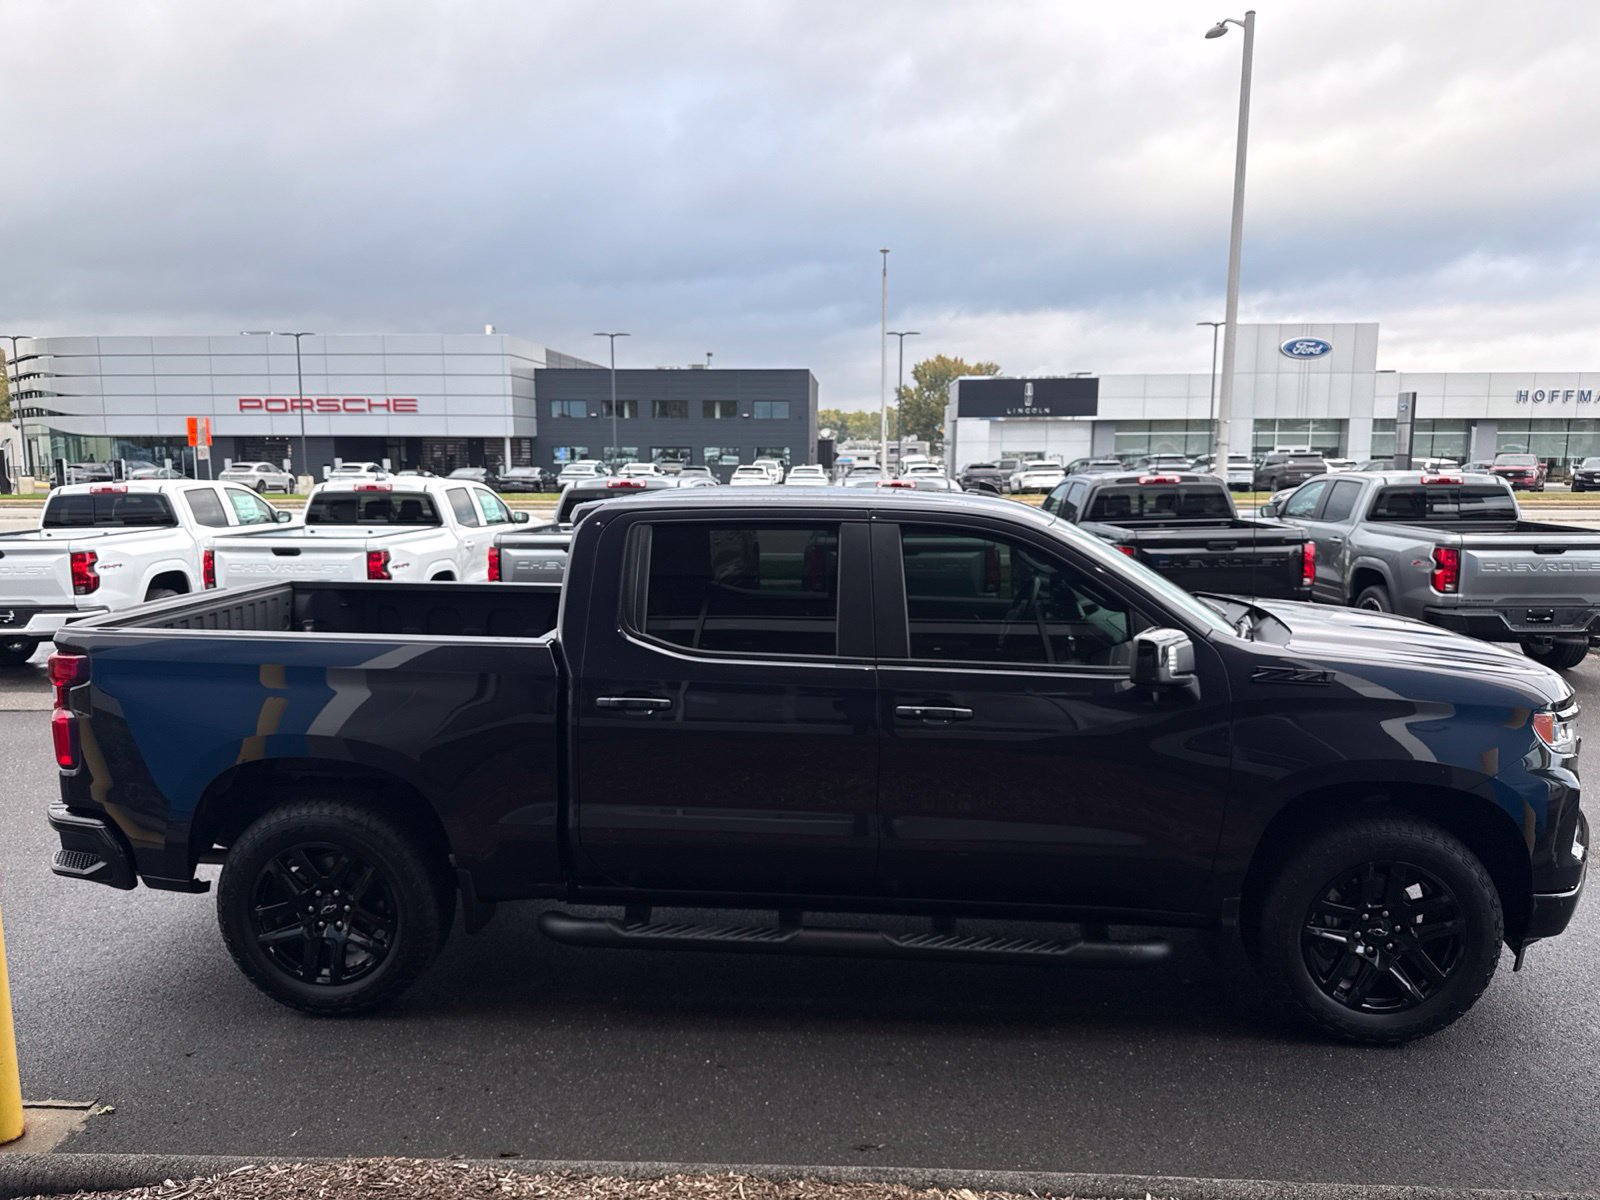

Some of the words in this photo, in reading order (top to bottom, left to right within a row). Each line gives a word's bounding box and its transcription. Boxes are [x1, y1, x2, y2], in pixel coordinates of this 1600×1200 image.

[1292, 341, 1323, 355] Ford
[238, 398, 418, 413] PORSCHE
[1006, 407, 1051, 415] LINCOLN
[227, 562, 350, 575] CHEVROLET
